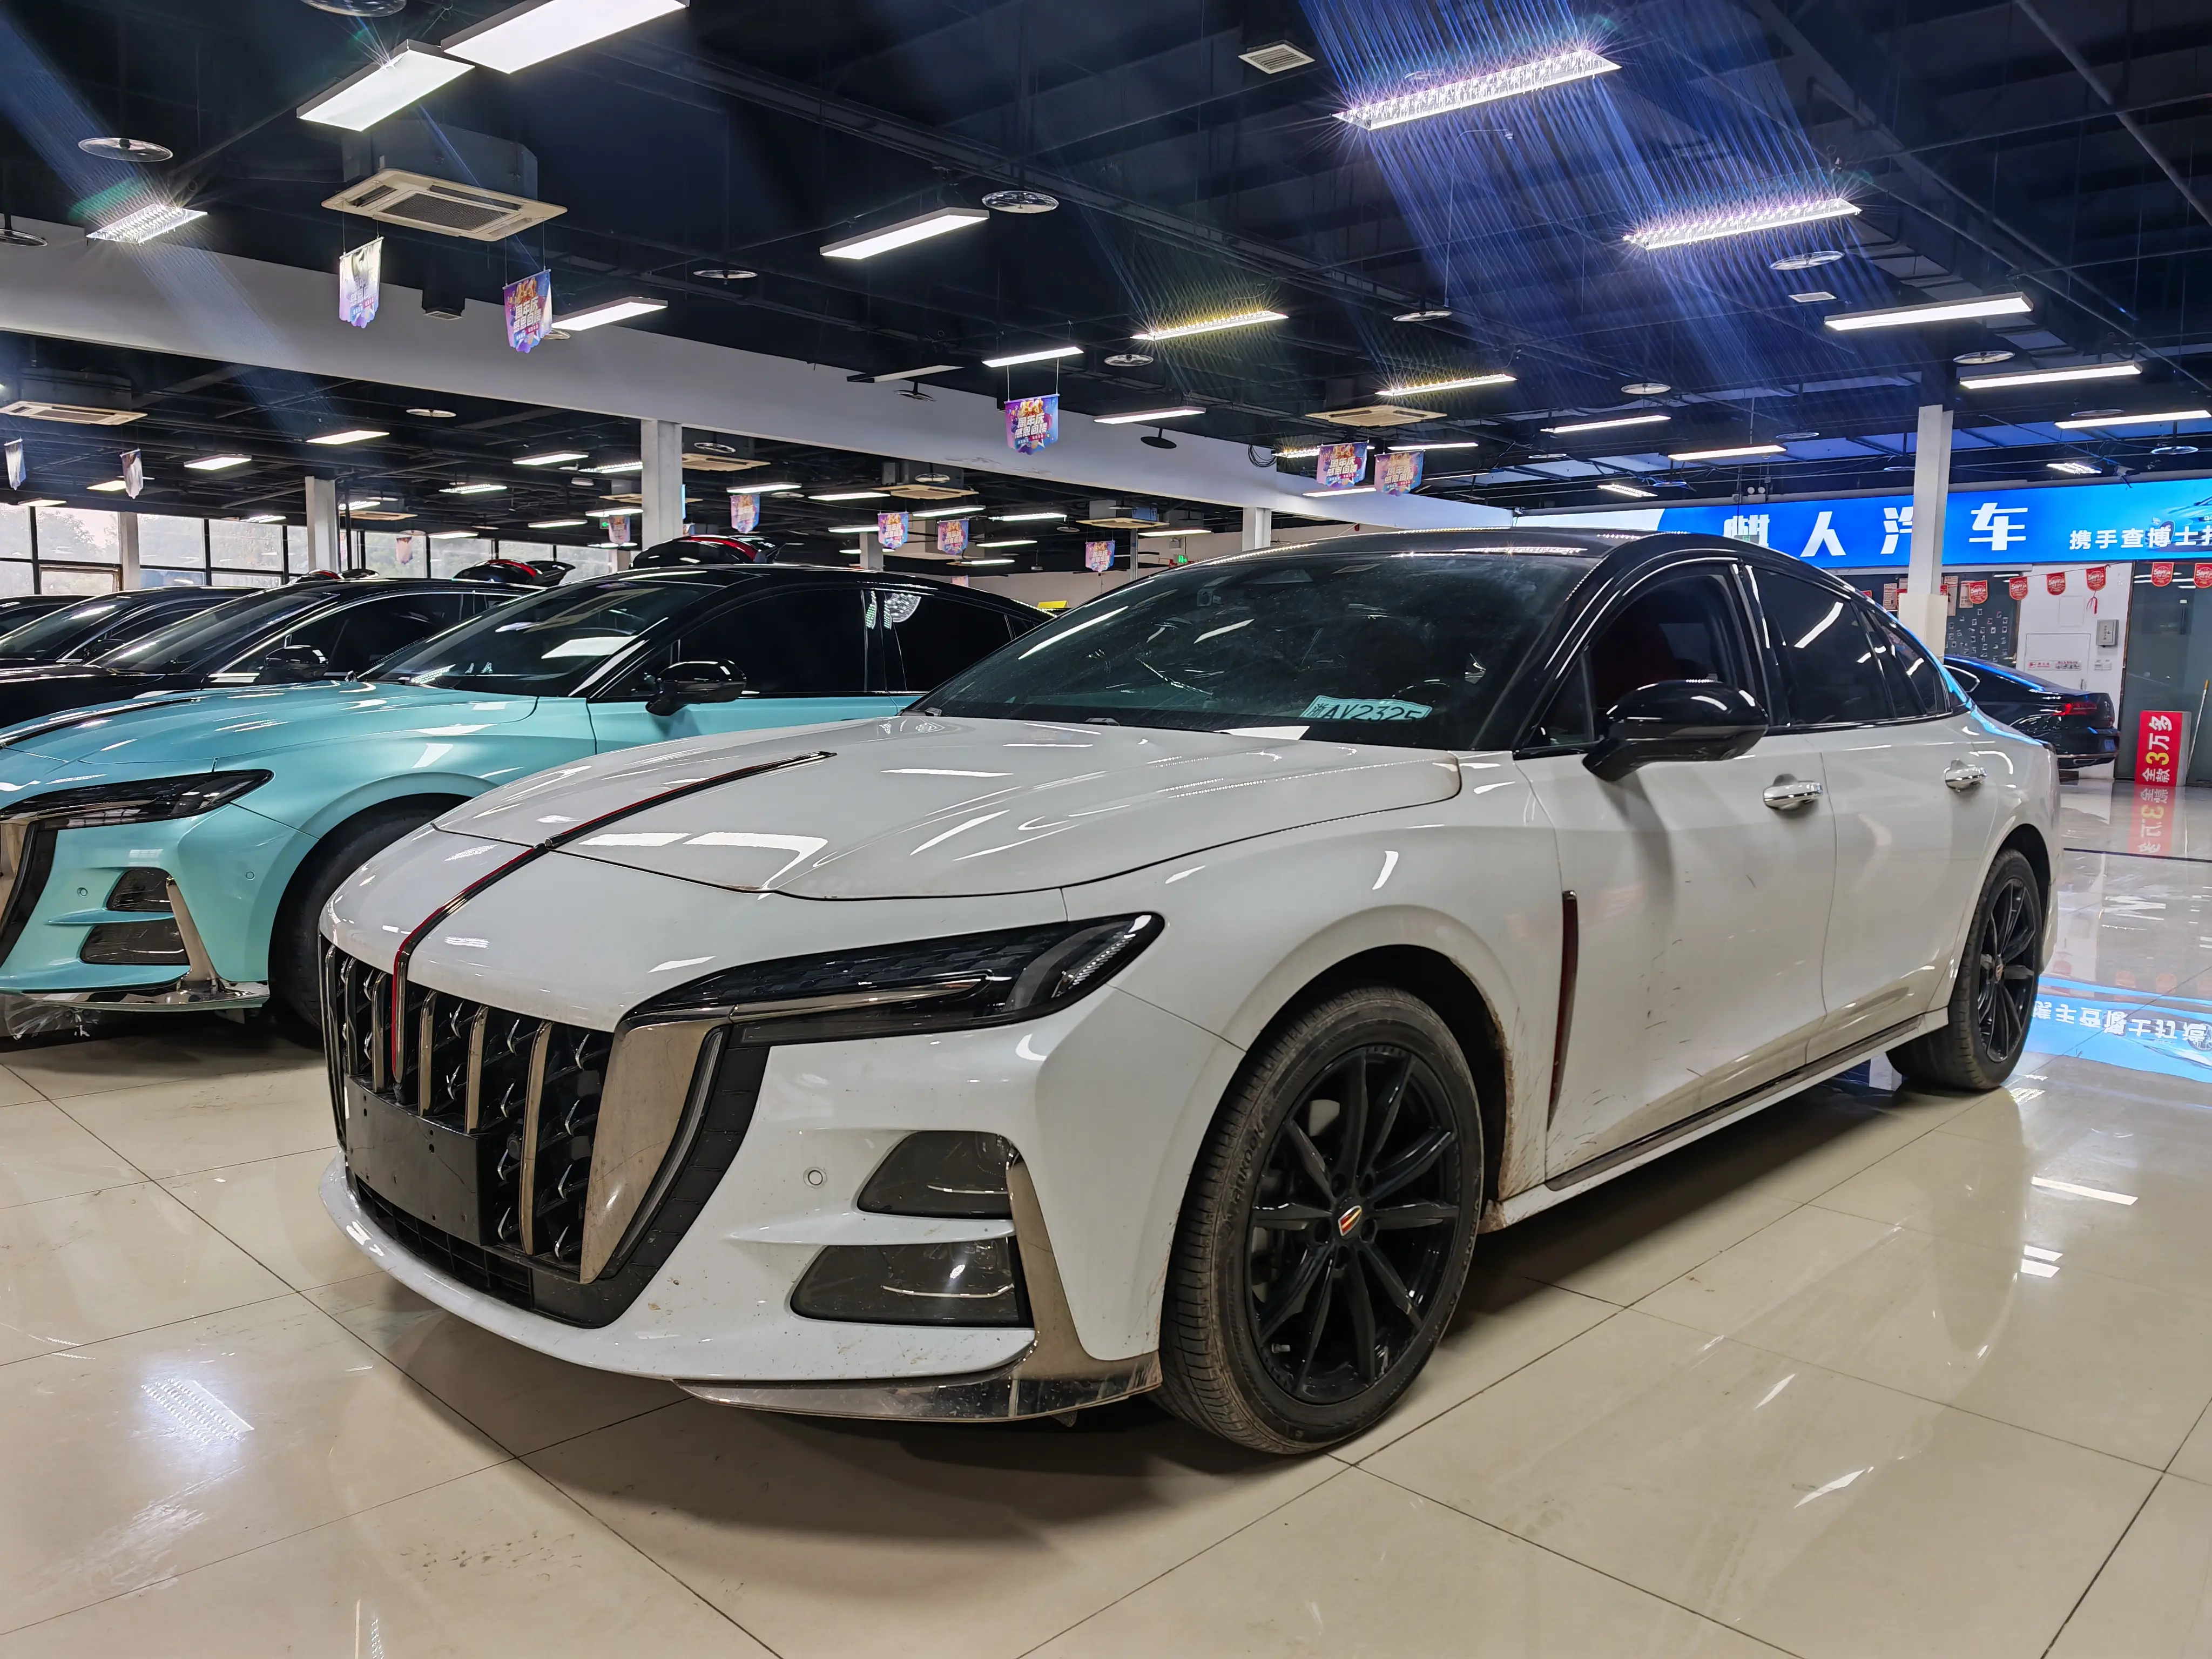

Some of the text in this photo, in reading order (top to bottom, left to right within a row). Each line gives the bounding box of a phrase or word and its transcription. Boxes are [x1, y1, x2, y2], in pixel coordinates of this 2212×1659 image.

[1017, 412, 1045, 428] 周年庆
[2142, 715, 2172, 783] 全款3万多
